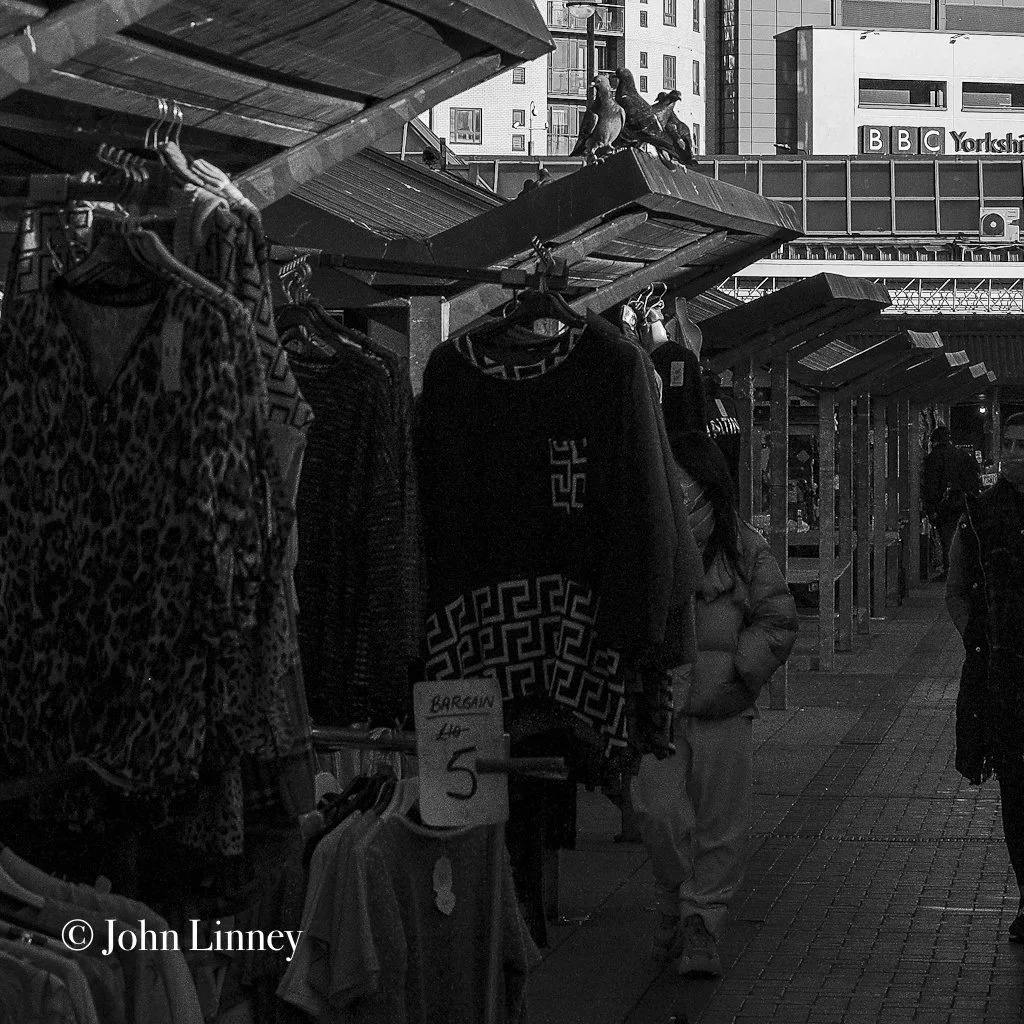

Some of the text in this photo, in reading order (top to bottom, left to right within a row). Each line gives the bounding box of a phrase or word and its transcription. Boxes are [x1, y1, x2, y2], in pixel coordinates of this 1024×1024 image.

[865, 127, 943, 153] BBC
[430, 694, 494, 713] BARGAIN
[446, 746, 478, 800] 5
